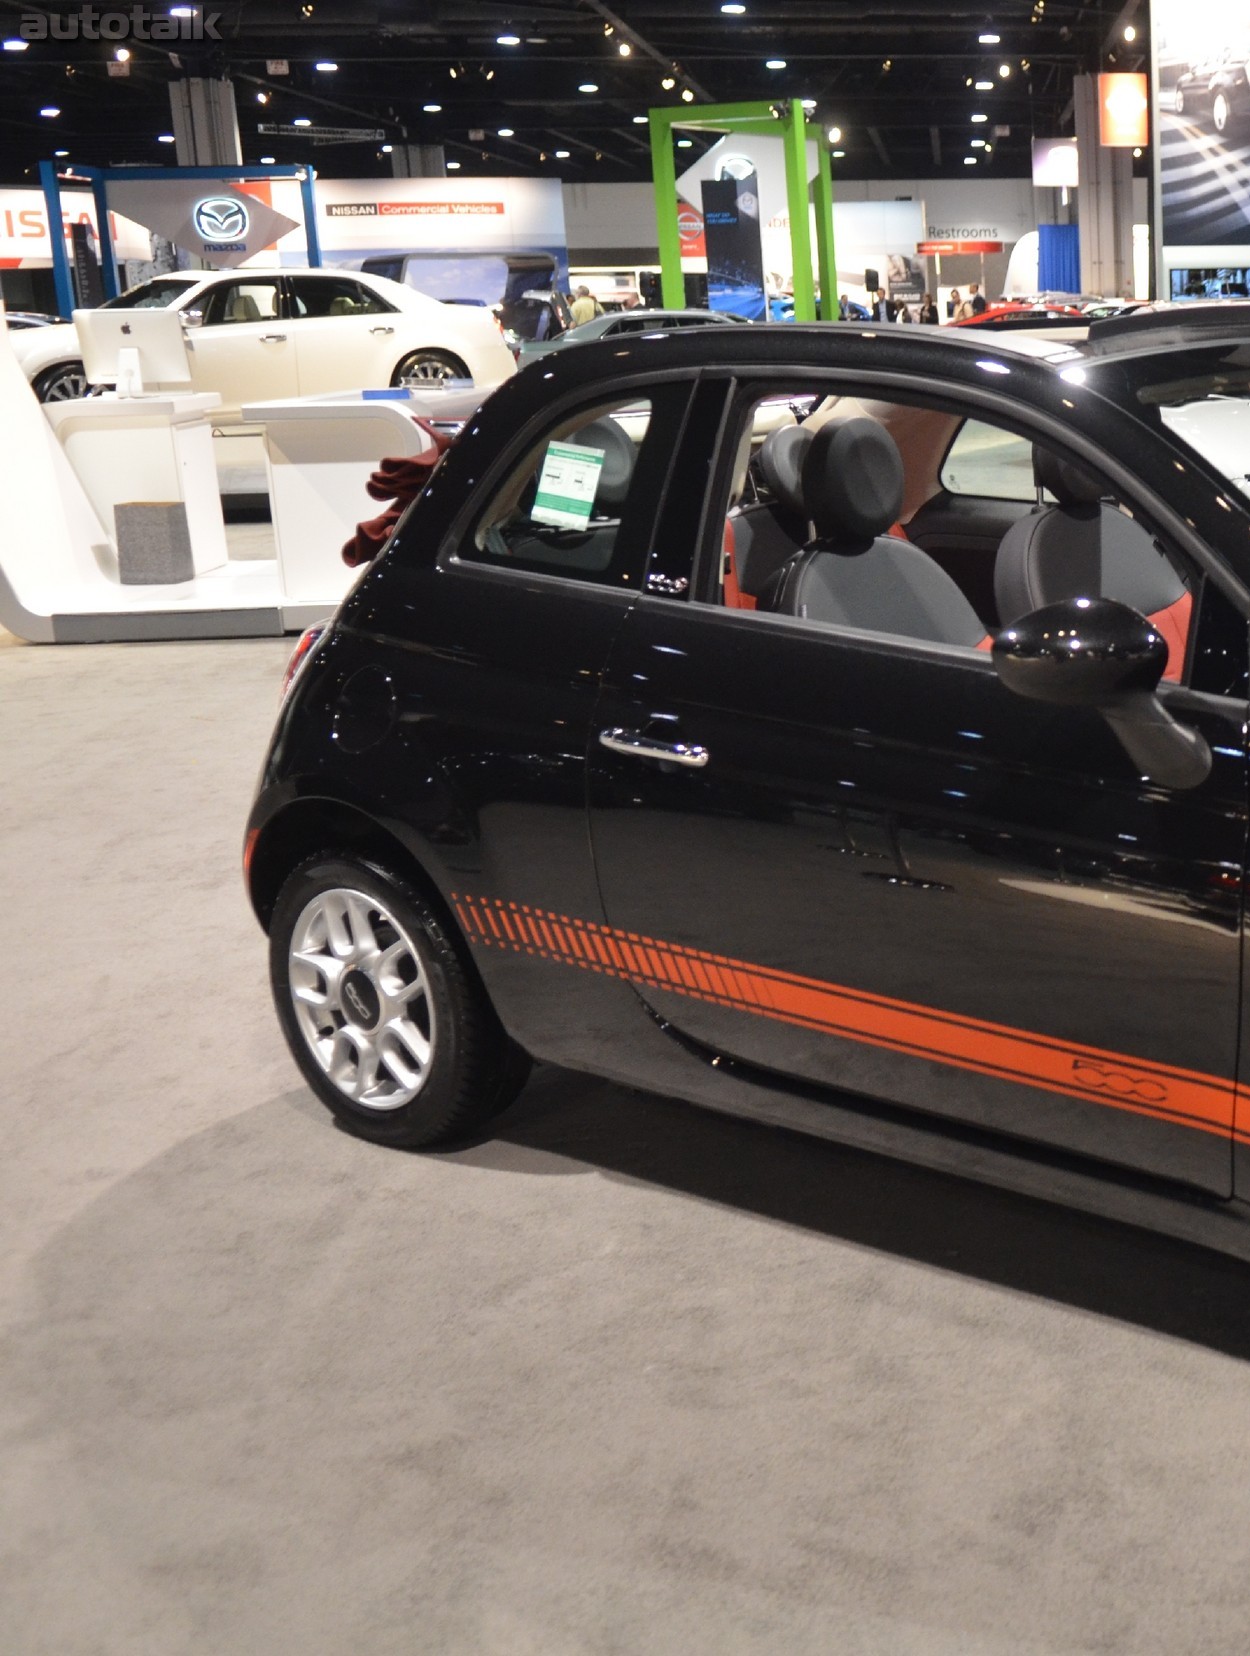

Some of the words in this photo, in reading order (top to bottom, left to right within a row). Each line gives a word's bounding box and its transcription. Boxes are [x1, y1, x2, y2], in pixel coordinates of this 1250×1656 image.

[332, 205, 376, 216] NISSAN
[381, 202, 450, 214] Commercial
[452, 202, 498, 214] Vehicles
[928, 226, 998, 239] Restrooms
[1072, 1059, 1168, 1102] 500
